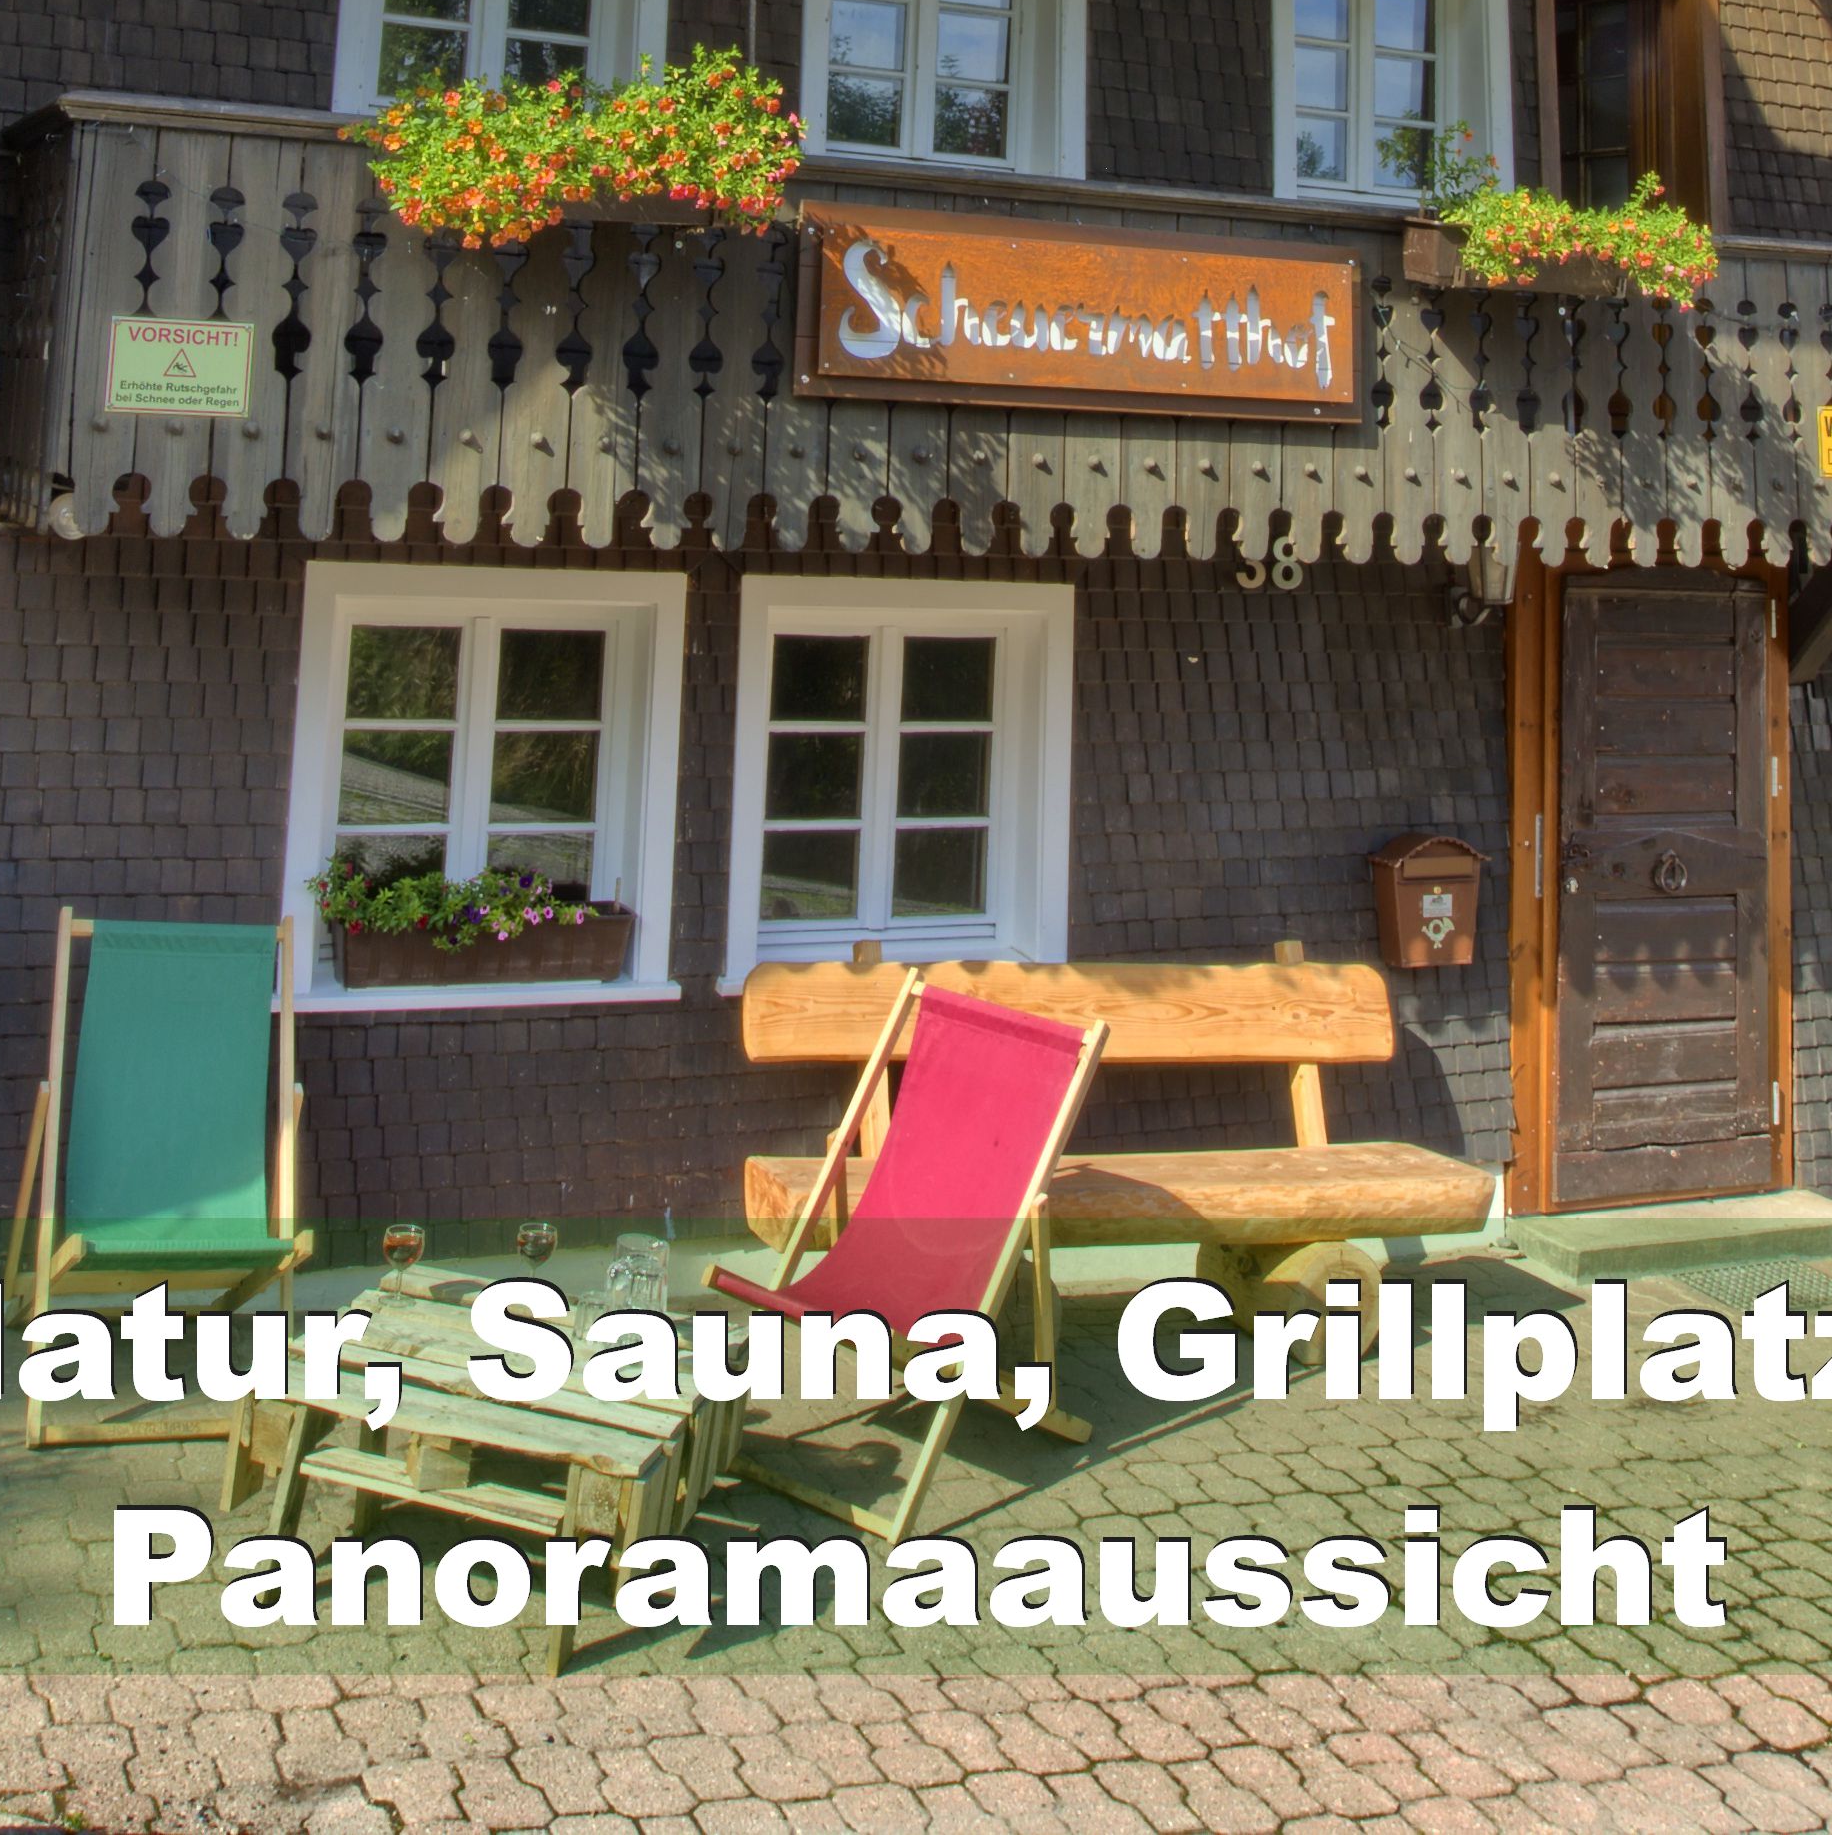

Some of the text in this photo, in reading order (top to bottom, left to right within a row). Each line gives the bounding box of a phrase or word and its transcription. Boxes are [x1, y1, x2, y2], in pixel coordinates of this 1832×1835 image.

[838, 239, 1336, 390] Scheuermatthof
[128, 325, 239, 347] VORSICHT!
[119, 380, 238, 396] Erhöhte Rutschgefahr
[115, 393, 240, 409] bei Schnee oder Regen
